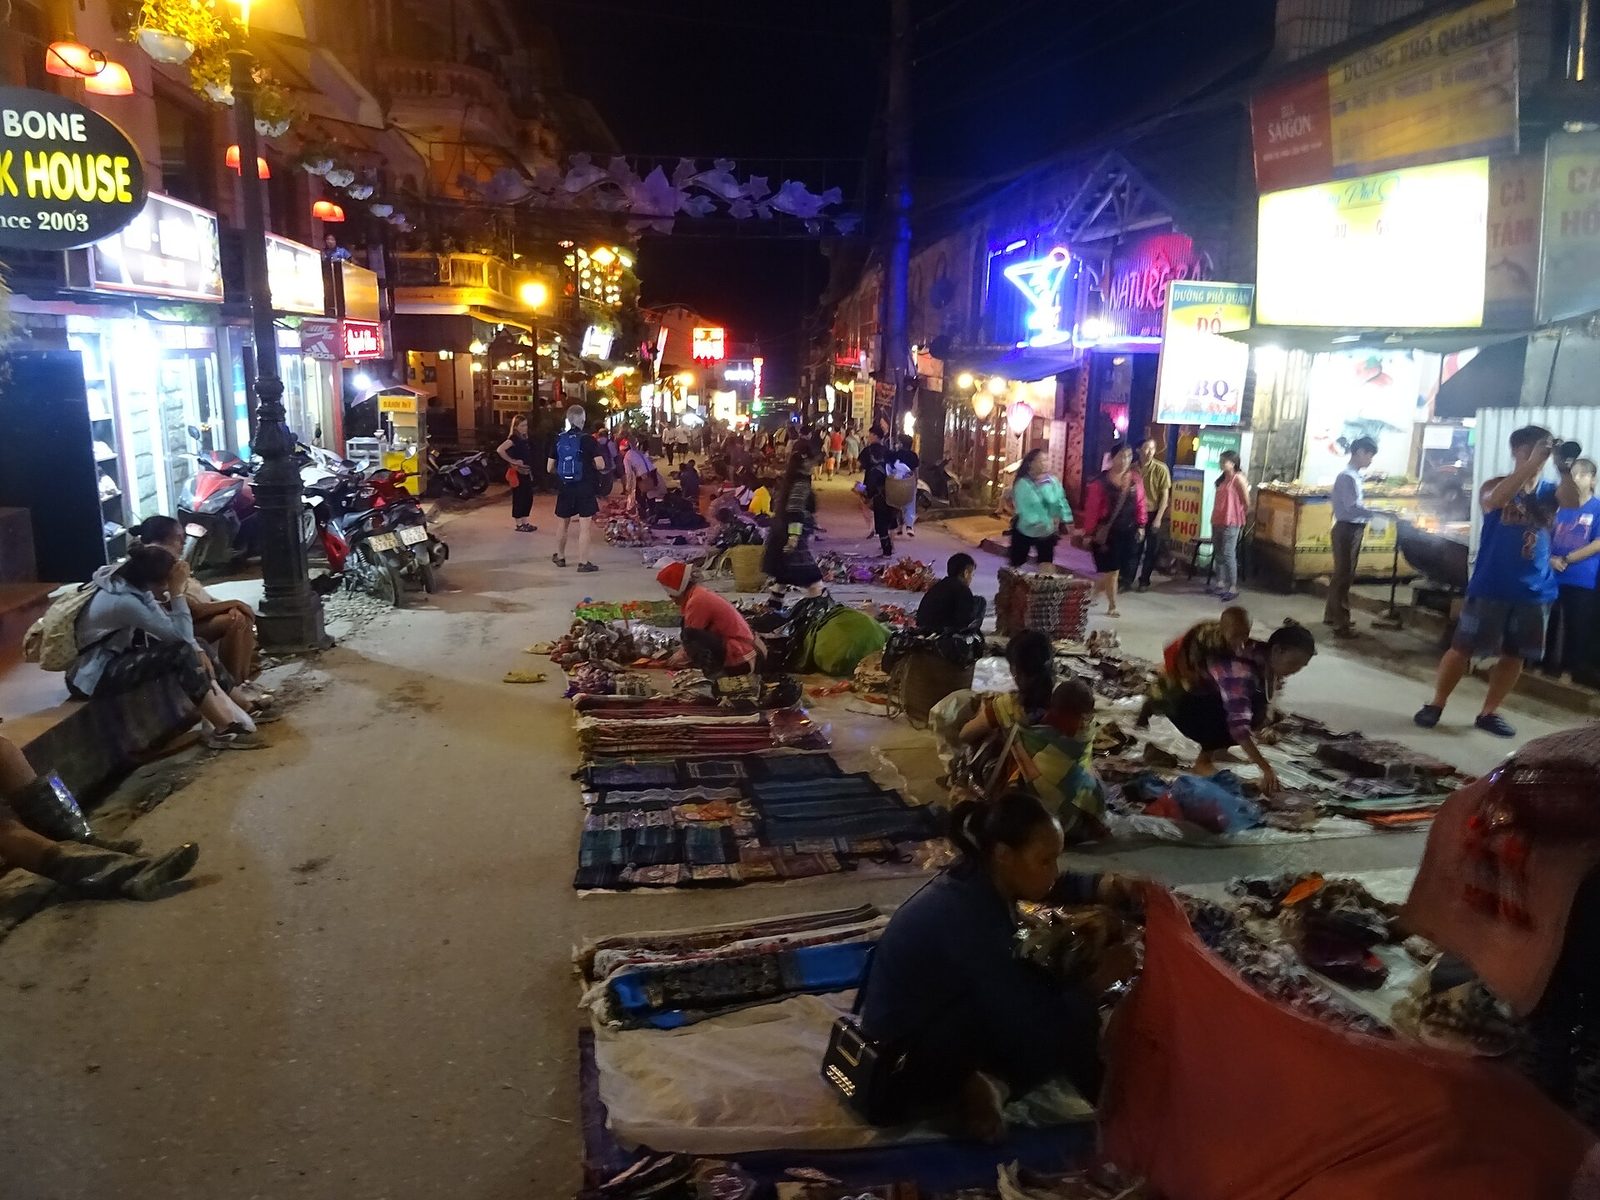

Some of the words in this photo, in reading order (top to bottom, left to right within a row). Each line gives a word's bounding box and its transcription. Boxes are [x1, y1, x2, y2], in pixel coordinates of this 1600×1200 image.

[2, 109, 88, 142] BONE
[1267, 113, 1312, 144] SAIGON
[24, 150, 133, 203] HOUSE
[37, 211, 90, 232] 2003
[1108, 269, 1171, 312] NATURE
